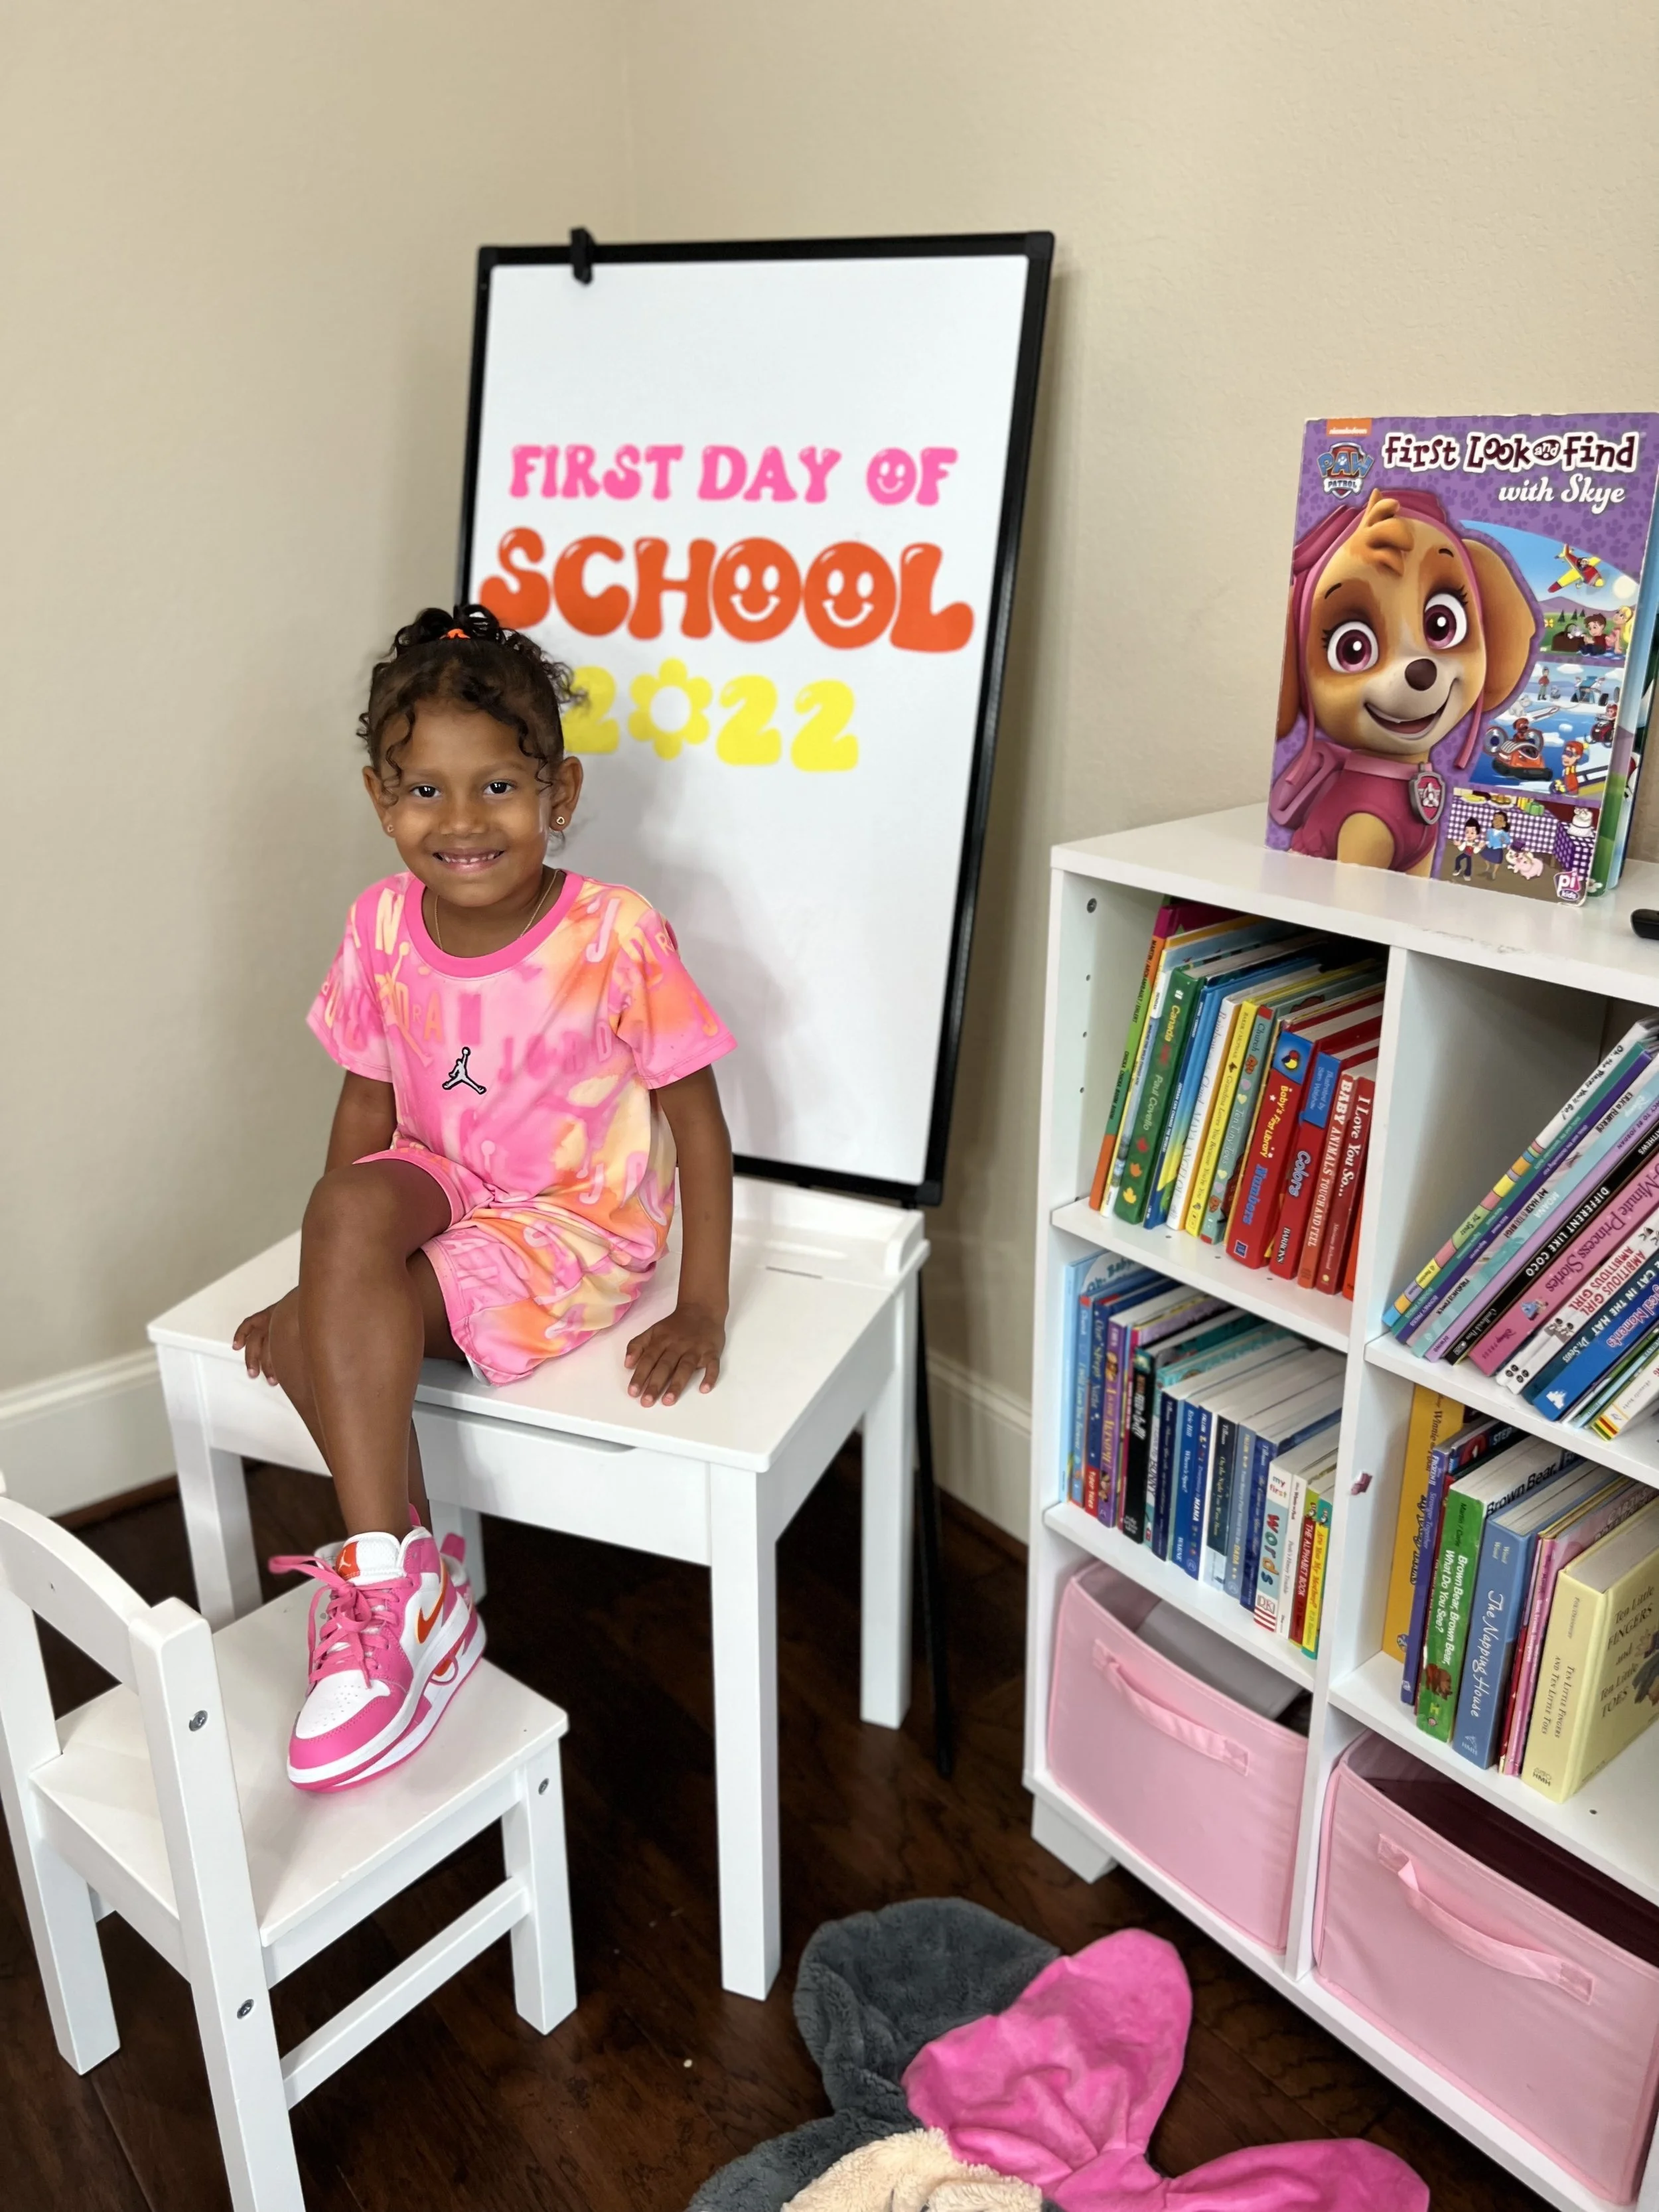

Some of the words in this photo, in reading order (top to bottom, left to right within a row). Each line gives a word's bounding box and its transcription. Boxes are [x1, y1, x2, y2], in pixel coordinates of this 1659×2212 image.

[1317, 451, 1374, 478] PAW
[1385, 435, 1457, 469] First
[1466, 435, 1531, 468] Look
[1534, 441, 1559, 459] and
[1563, 435, 1636, 468] Find
[509, 444, 684, 500] FIRST
[697, 445, 842, 503] DAY
[865, 447, 959, 506] OF
[1327, 479, 1358, 489] PATROL
[1498, 476, 1554, 502] with
[1561, 473, 1625, 514] Skye
[478, 527, 974, 653] SCHOOL
[1561, 889, 1577, 900] kids
[1146, 939, 1157, 961] MARTIN
[1163, 1004, 1181, 1043] Canada
[1251, 1021, 1265, 1053] Church
[1601, 1057, 1613, 1070] the
[1610, 1044, 1624, 1060] Oh,
[1150, 1074, 1163, 1094] Paul
[1585, 1067, 1605, 1090] Places
[1272, 1082, 1291, 1116] Baby's
[1332, 1078, 1353, 1125] BABY
[1357, 1096, 1371, 1106] I
[1572, 1086, 1588, 1106] You'll
[1141, 1096, 1158, 1131] Covello
[1231, 1108, 1244, 1125] Ten
[1266, 1112, 1281, 1132] First
[1350, 1105, 1369, 1140] Love
[1559, 1102, 1574, 1120] Go!
[1641, 1112, 1651, 1121] TO
[1226, 1124, 1240, 1144] Tiny
[1258, 1128, 1275, 1159] Library
[1616, 1127, 1637, 1149] JORDAN
[1220, 1145, 1234, 1166] Toes
[1321, 1126, 1342, 1176] ANIMALS
[1344, 1142, 1360, 1167] You
[1289, 1151, 1311, 1197] Colors
[1337, 1167, 1354, 1198] So...
[1242, 1163, 1268, 1226] Numbers
[1315, 1177, 1331, 1207] TOUCH
[1534, 1186, 1548, 1201] MY
[1534, 1191, 1560, 1218] MOANA
[1311, 1205, 1325, 1226] AND
[1524, 1197, 1540, 1214] HAIR
[1565, 1185, 1609, 1233] DIFFERENT
[1306, 1226, 1320, 1247] FEEL
[1547, 1230, 1568, 1253] LIKE
[1577, 1210, 1625, 1264] Princess
[1524, 1250, 1550, 1277] COCO
[1545, 1252, 1585, 1297] Stories
[1589, 1246, 1634, 1291] AMBITIOUS
[1601, 1250, 1648, 1296] AMBITIOUS
[1634, 1268, 1657, 1290] CAT
[1568, 1286, 1593, 1311] GIRL
[1579, 1291, 1606, 1317] GIRL
[1623, 1286, 1638, 1301] IN
[1608, 1297, 1627, 1317] THE
[1589, 1314, 1611, 1336] HAT
[1606, 1305, 1646, 1349] Moments
[1561, 1345, 1581, 1365] Seuss
[1575, 1335, 1590, 1351] Dr.
[1429, 1455, 1439, 1481] FROZEN
[1269, 1483, 1287, 1498] first
[1272, 1475, 1286, 1488] my
[1426, 1491, 1437, 1519] Stronger
[1486, 1483, 1526, 1516] Brown
[1458, 1503, 1467, 1524] Martin
[1303, 1522, 1313, 1538] THE
[1423, 1520, 1432, 1549] Together
[1232, 1543, 1241, 1566] DADA
[1261, 1513, 1280, 1586] words
[1299, 1538, 1311, 1576] ALPHABET
[1442, 1549, 1455, 1574] What
[1440, 1574, 1451, 1589] Do
[1453, 1555, 1468, 1587] Brown
[1297, 1575, 1307, 1597] BOOK
[1437, 1590, 1449, 1608] You
[1449, 1585, 1463, 1611] Bear,
[1258, 1595, 1275, 1613] DK
[1487, 1589, 1504, 1619] The
[1615, 1605, 1630, 1625] Ten
[1631, 1585, 1655, 1611] Little
[1435, 1607, 1446, 1633] See?
[1446, 1611, 1459, 1642] Brown
[1607, 1603, 1653, 1651] FINGERS
[1441, 1641, 1454, 1665] Bear,
[1472, 1619, 1500, 1672] Napping
[1615, 1642, 1633, 1666] and
[1552, 1656, 1561, 1671] AND
[1471, 1671, 1490, 1718] House
[1600, 1682, 1615, 1702] Ten
[1615, 1662, 1639, 1687] Little
[1601, 1686, 1629, 1718] TOES
